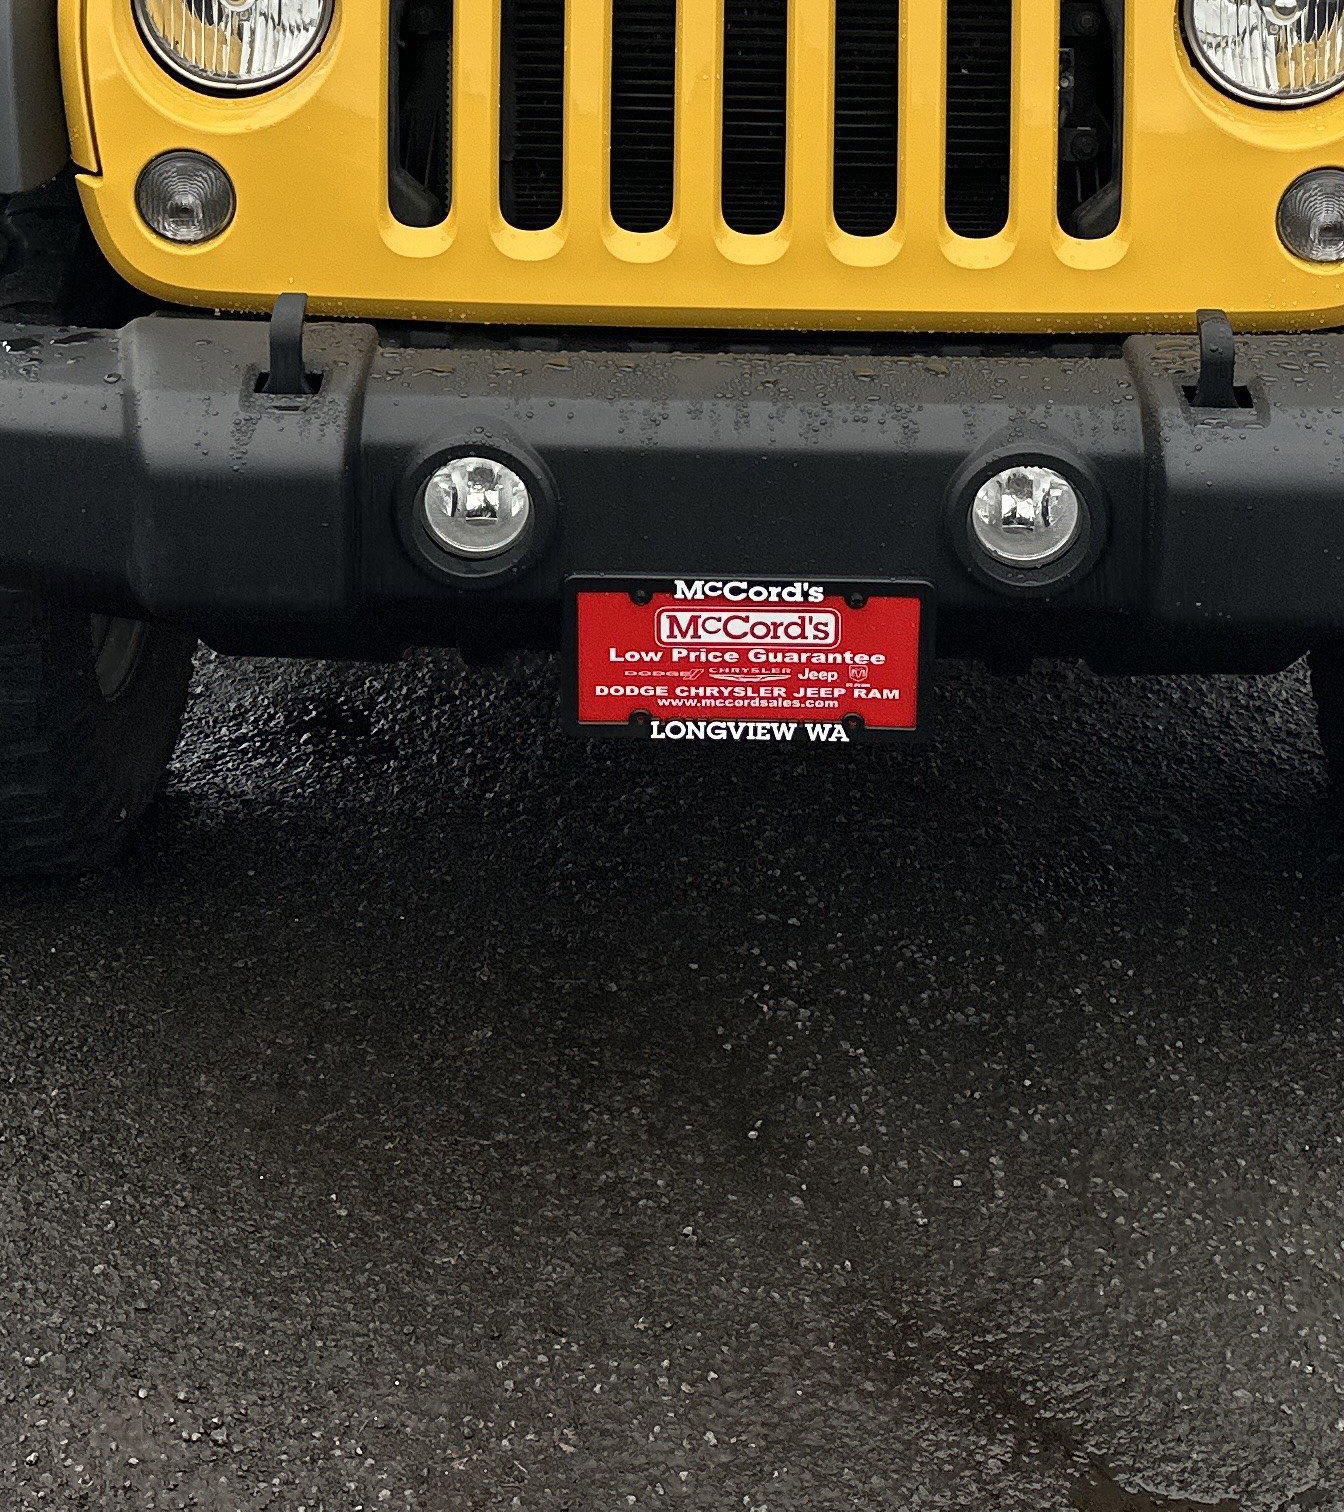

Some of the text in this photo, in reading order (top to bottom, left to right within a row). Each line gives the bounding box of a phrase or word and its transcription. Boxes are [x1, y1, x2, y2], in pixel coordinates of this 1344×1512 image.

[673, 579, 825, 603] McCord's
[665, 614, 830, 641] McCord's
[609, 648, 886, 665] Low Price Guarantee
[797, 667, 839, 682] Jeep
[595, 685, 900, 700] DODGE CHRYSLER JEEP RAM
[657, 697, 839, 708] www.mccordsales.com
[650, 720, 850, 742] LONGVIEW WA
